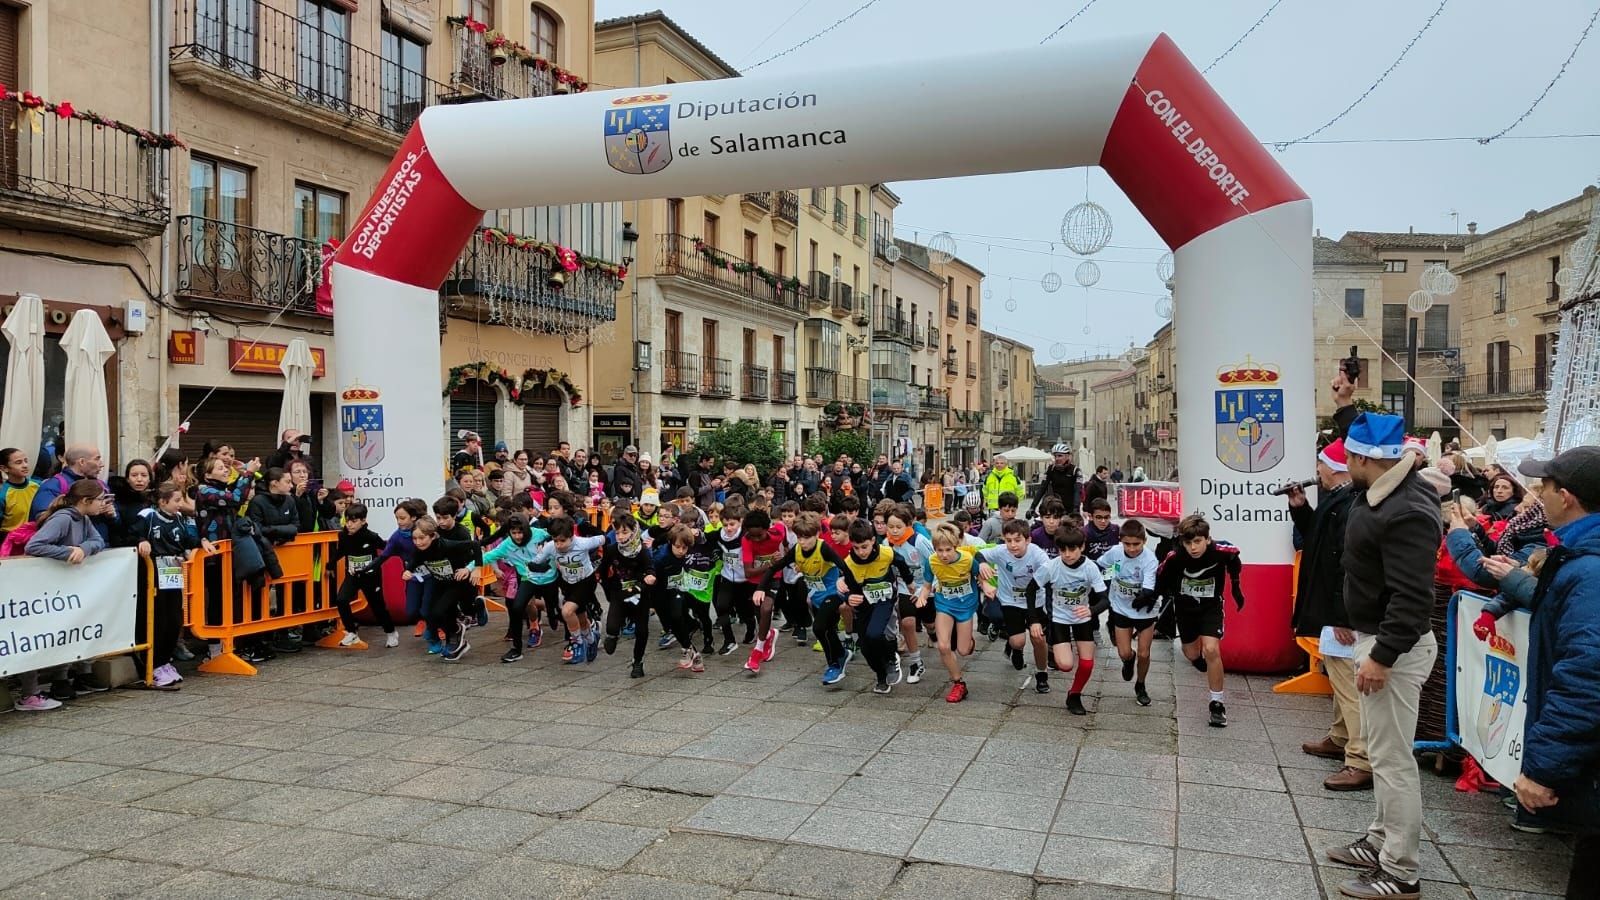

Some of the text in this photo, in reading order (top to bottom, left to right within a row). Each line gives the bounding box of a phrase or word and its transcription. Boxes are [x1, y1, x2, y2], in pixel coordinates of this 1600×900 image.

[677, 91, 818, 121] Diputación
[678, 129, 847, 157] de Salamanca
[1146, 90, 1250, 206] CON EL DEPORTE
[352, 152, 417, 254] CON NUESTROS
[362, 170, 422, 260] DEPORTISTAS
[166, 575, 179, 583] 745
[0, 622, 104, 656] alamanca
[1508, 733, 1522, 761] de
